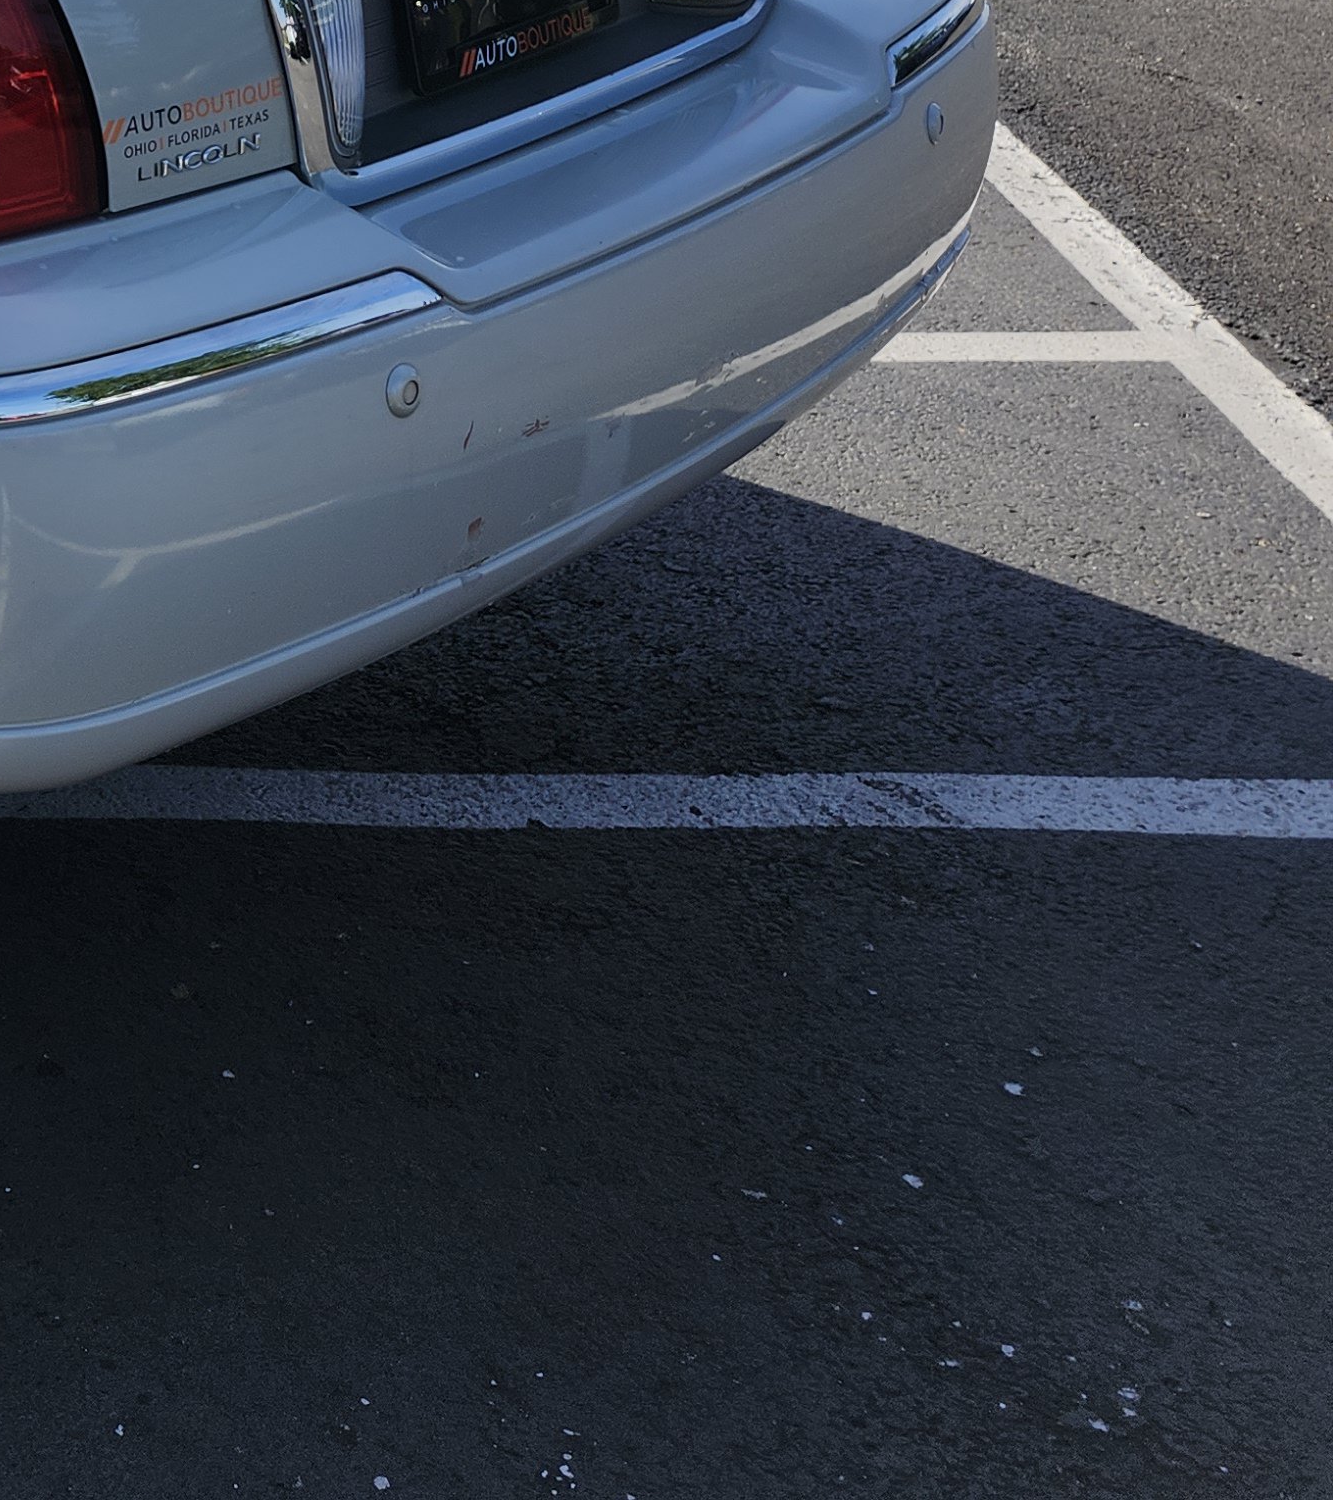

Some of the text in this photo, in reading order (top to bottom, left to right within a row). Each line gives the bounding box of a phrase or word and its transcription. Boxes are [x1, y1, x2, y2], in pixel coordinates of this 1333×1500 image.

[124, 109, 269, 159] OHIO FLORIDA TEXAS
[137, 132, 261, 182] LINCOLN
